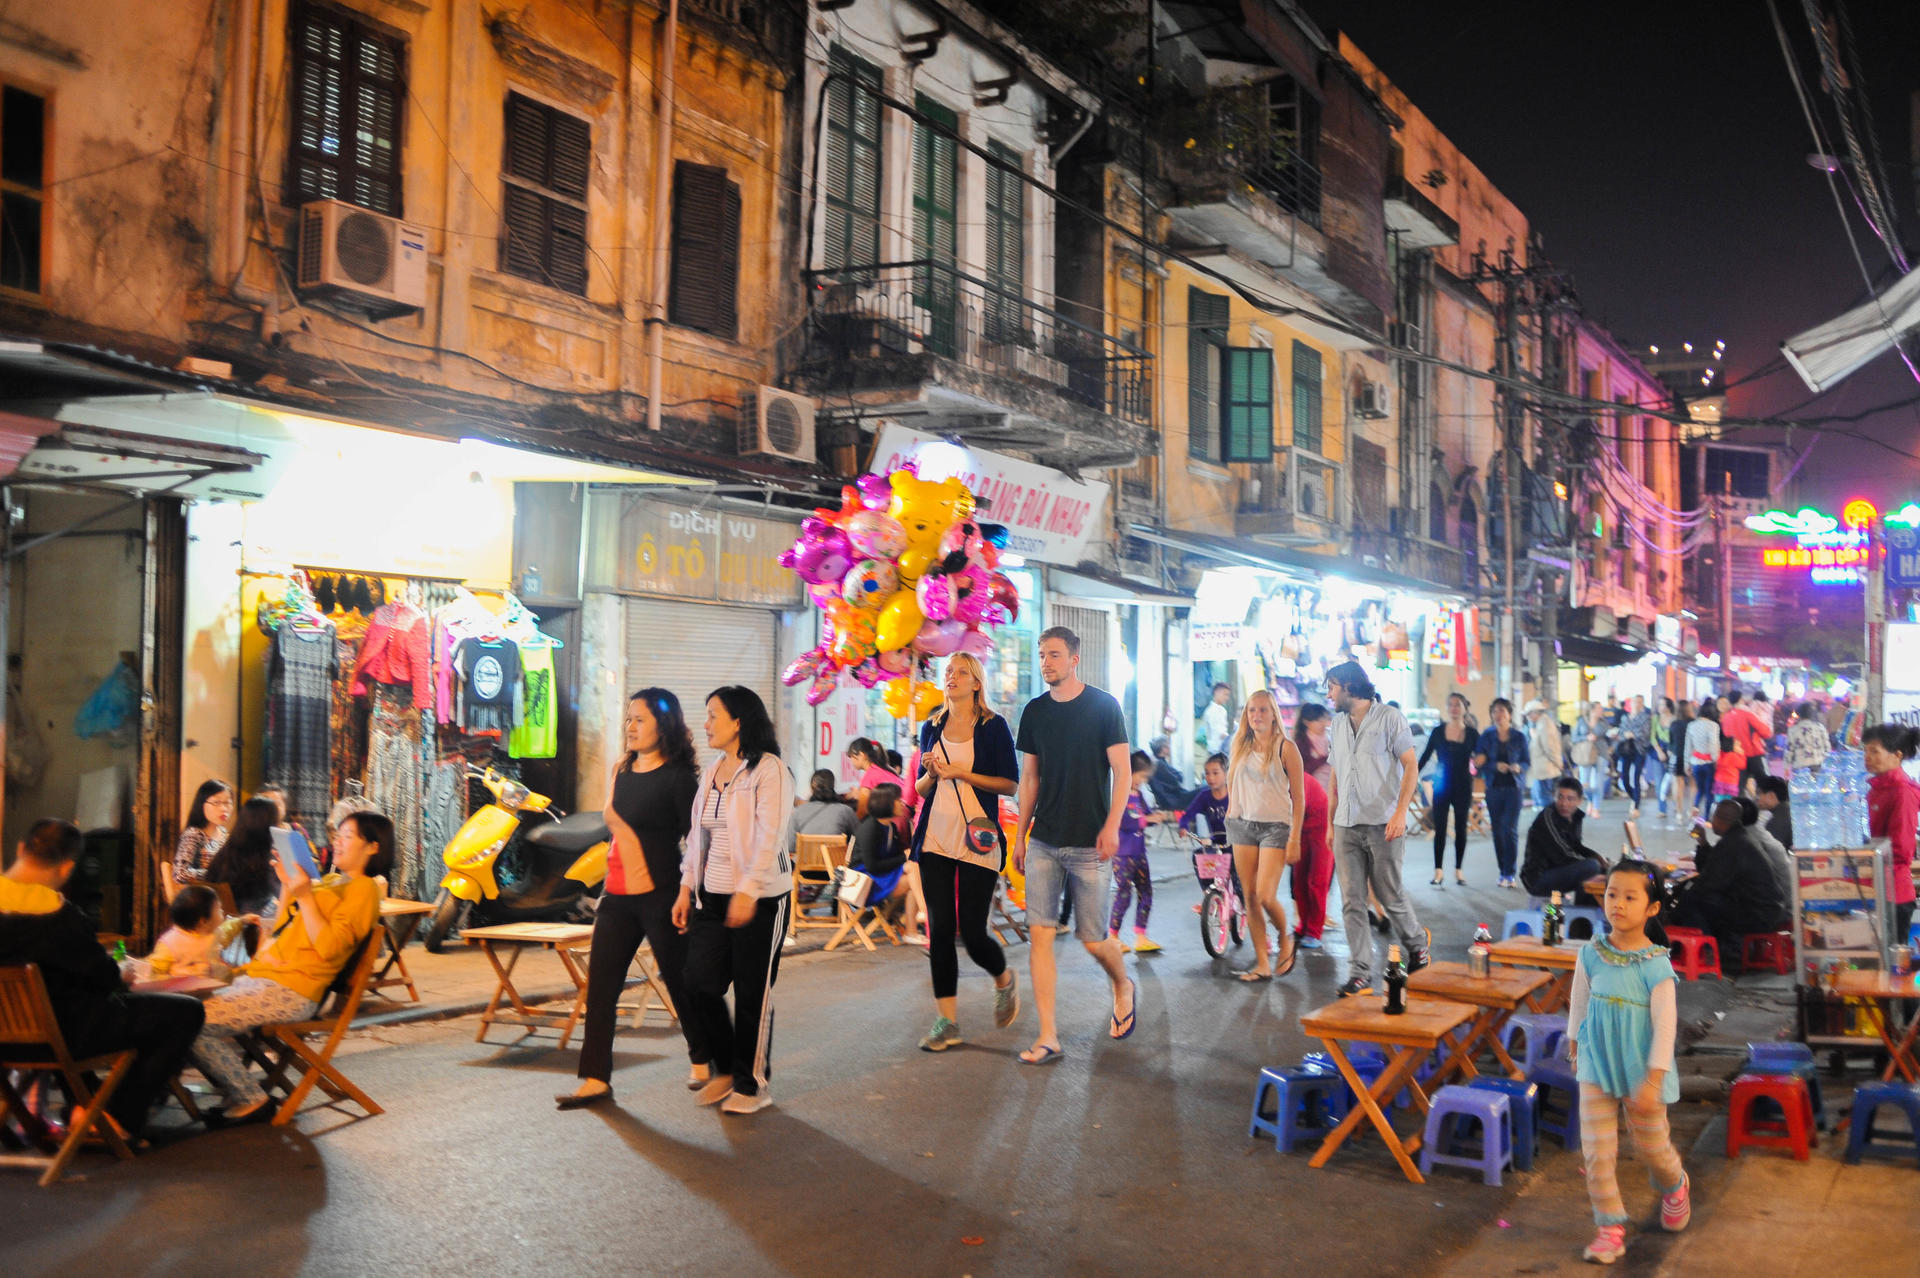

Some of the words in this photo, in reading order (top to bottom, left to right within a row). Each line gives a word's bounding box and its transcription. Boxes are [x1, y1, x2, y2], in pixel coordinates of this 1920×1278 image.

[728, 519, 757, 543] VỤ
[635, 531, 659, 576] Ô
[665, 537, 706, 580] TÔ
